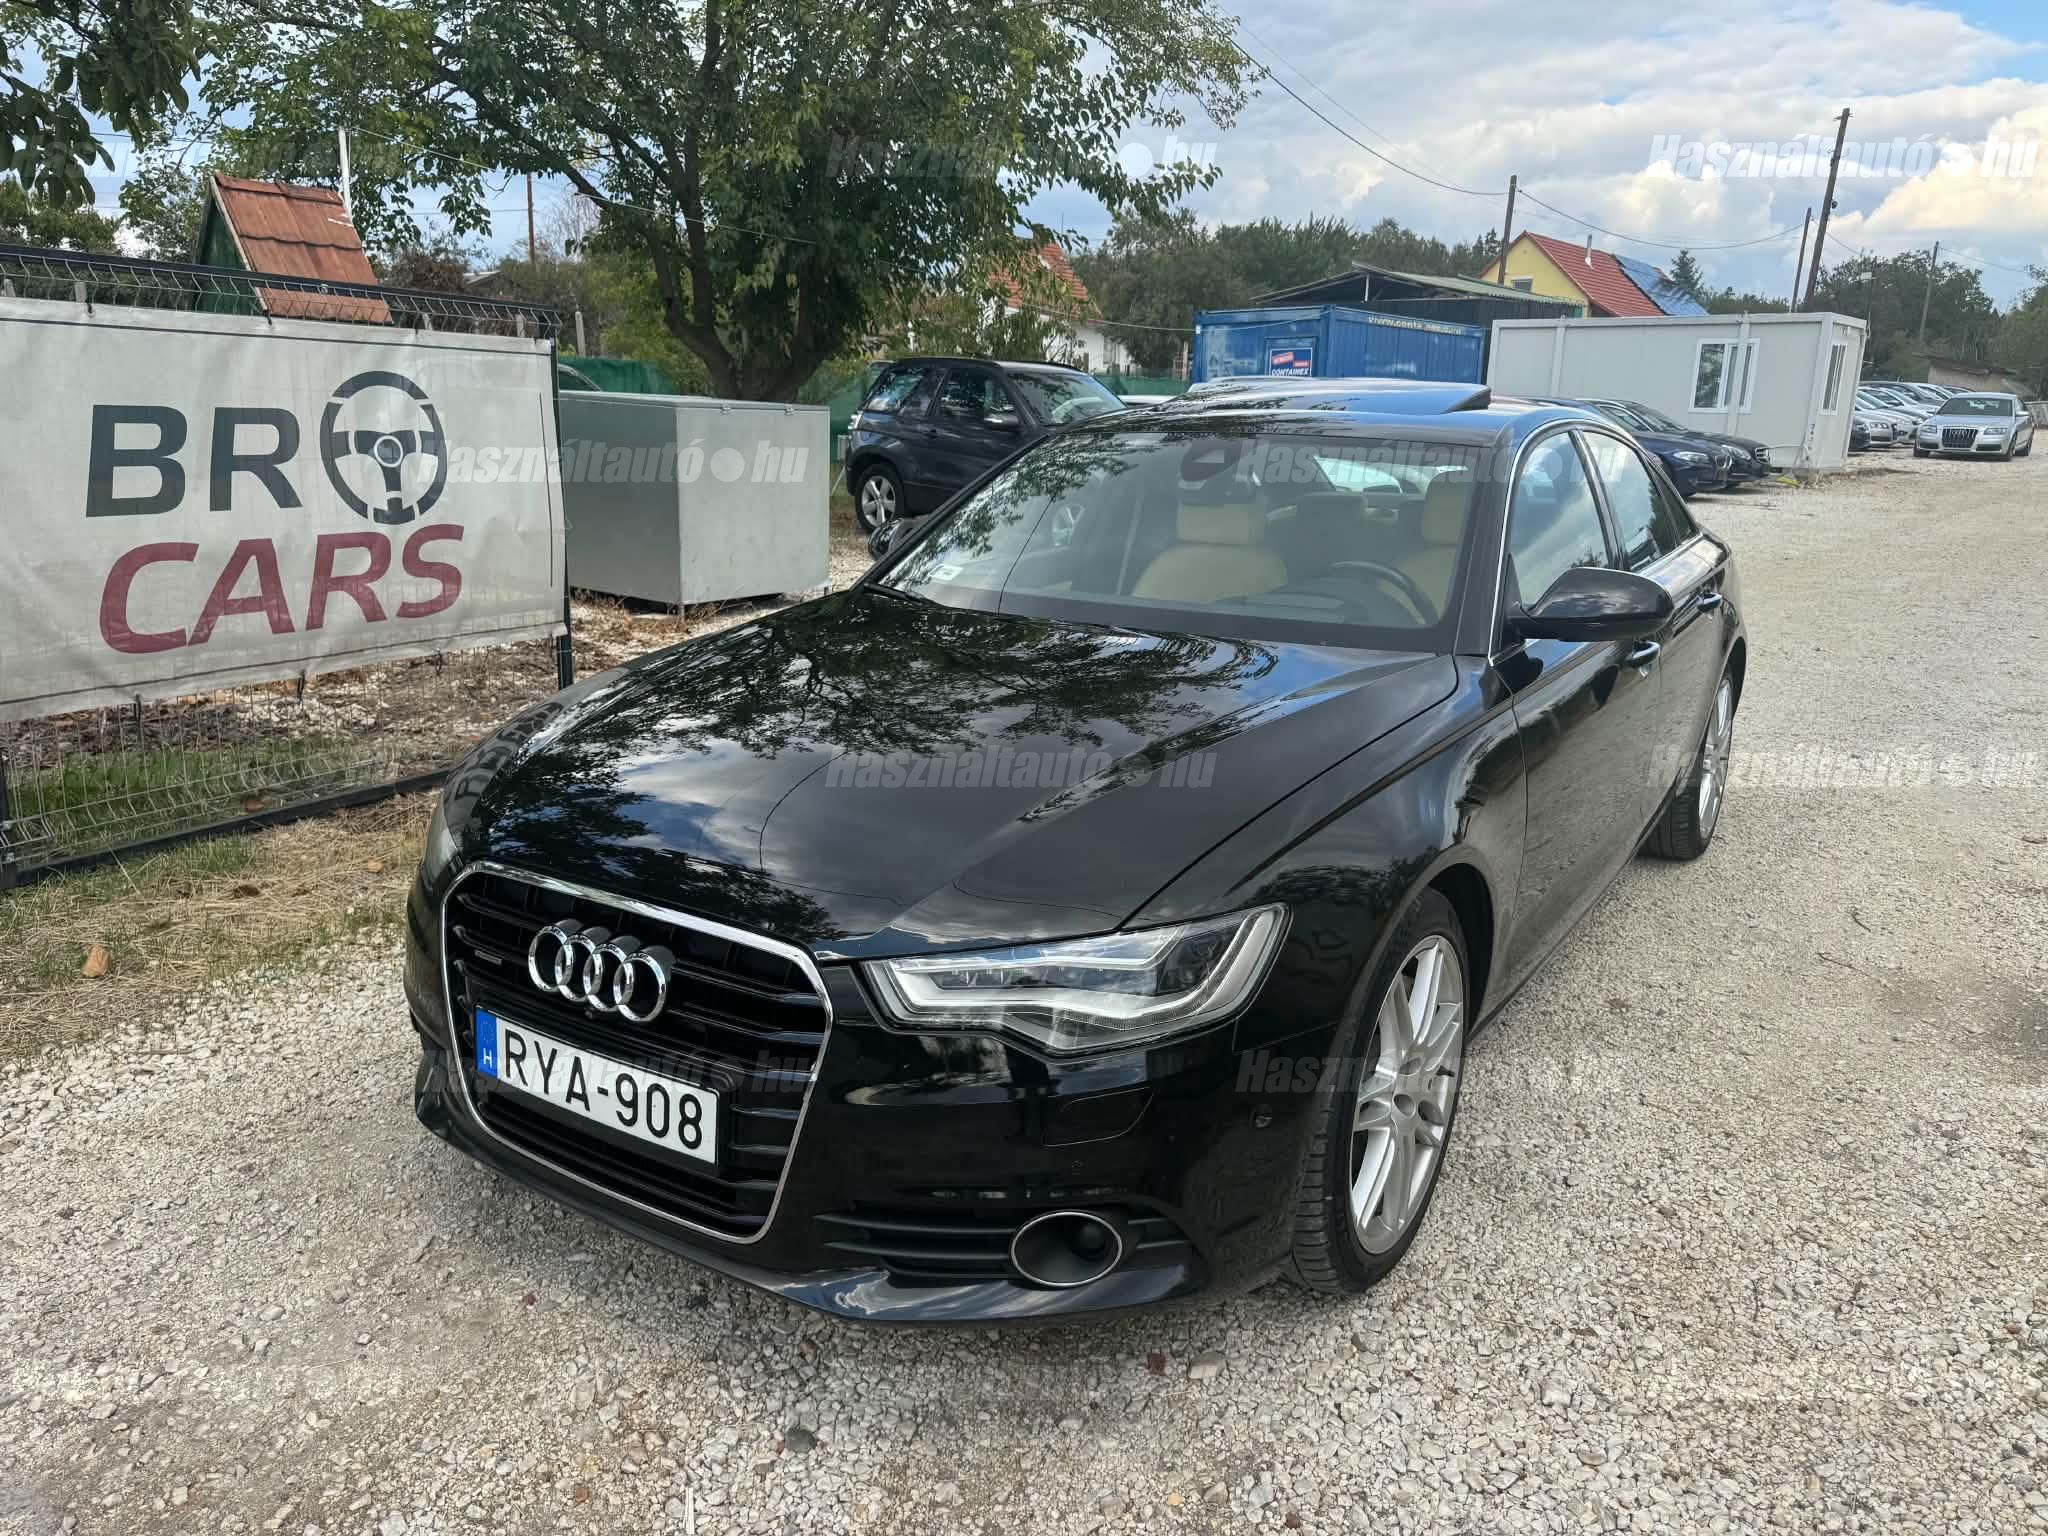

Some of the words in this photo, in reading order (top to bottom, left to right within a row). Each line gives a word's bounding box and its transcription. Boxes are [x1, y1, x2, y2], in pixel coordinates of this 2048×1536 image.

[100, 524, 464, 654] CARS
[483, 1048, 492, 1067] H
[505, 1028, 702, 1150] RYA-908
